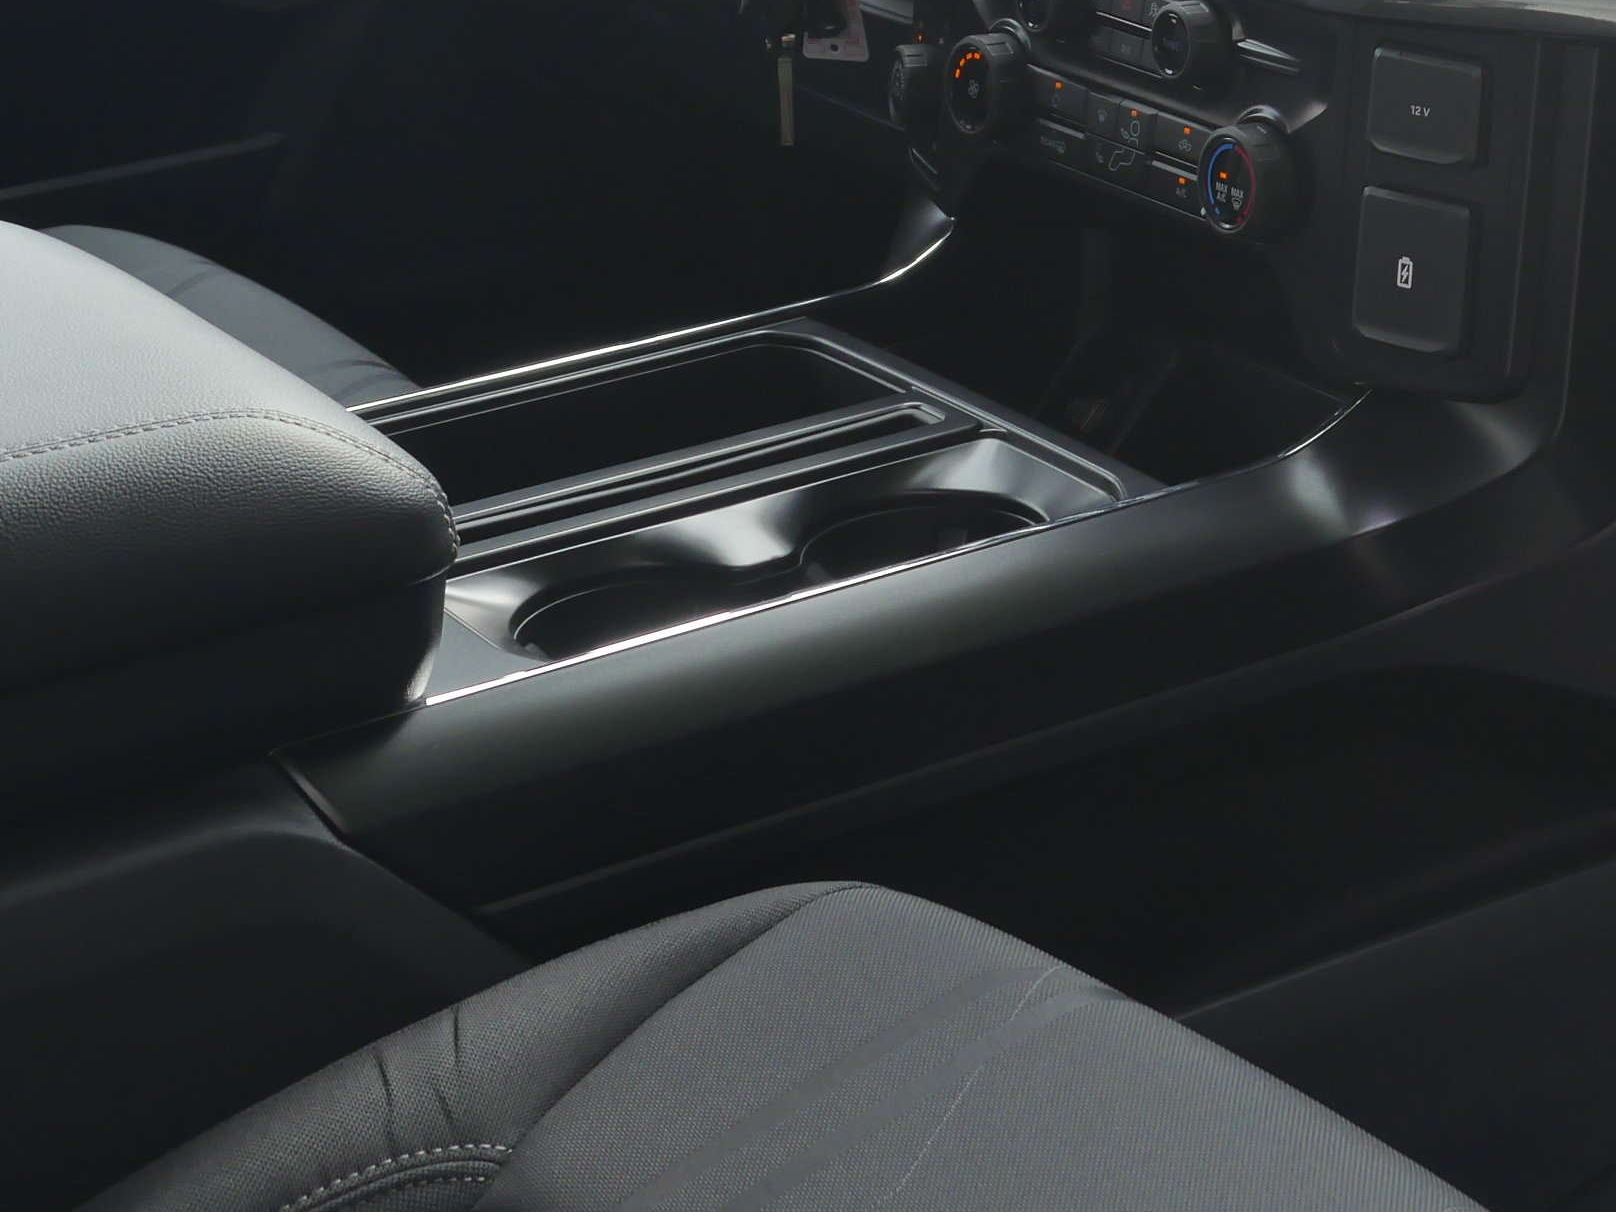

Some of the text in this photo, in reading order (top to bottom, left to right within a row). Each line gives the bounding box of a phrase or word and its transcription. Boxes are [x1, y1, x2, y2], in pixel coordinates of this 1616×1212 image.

[1411, 105, 1430, 117] 12 V
[1215, 181, 1228, 193] MAX
[1231, 187, 1244, 199] MAX
[1216, 192, 1226, 203] A/C
